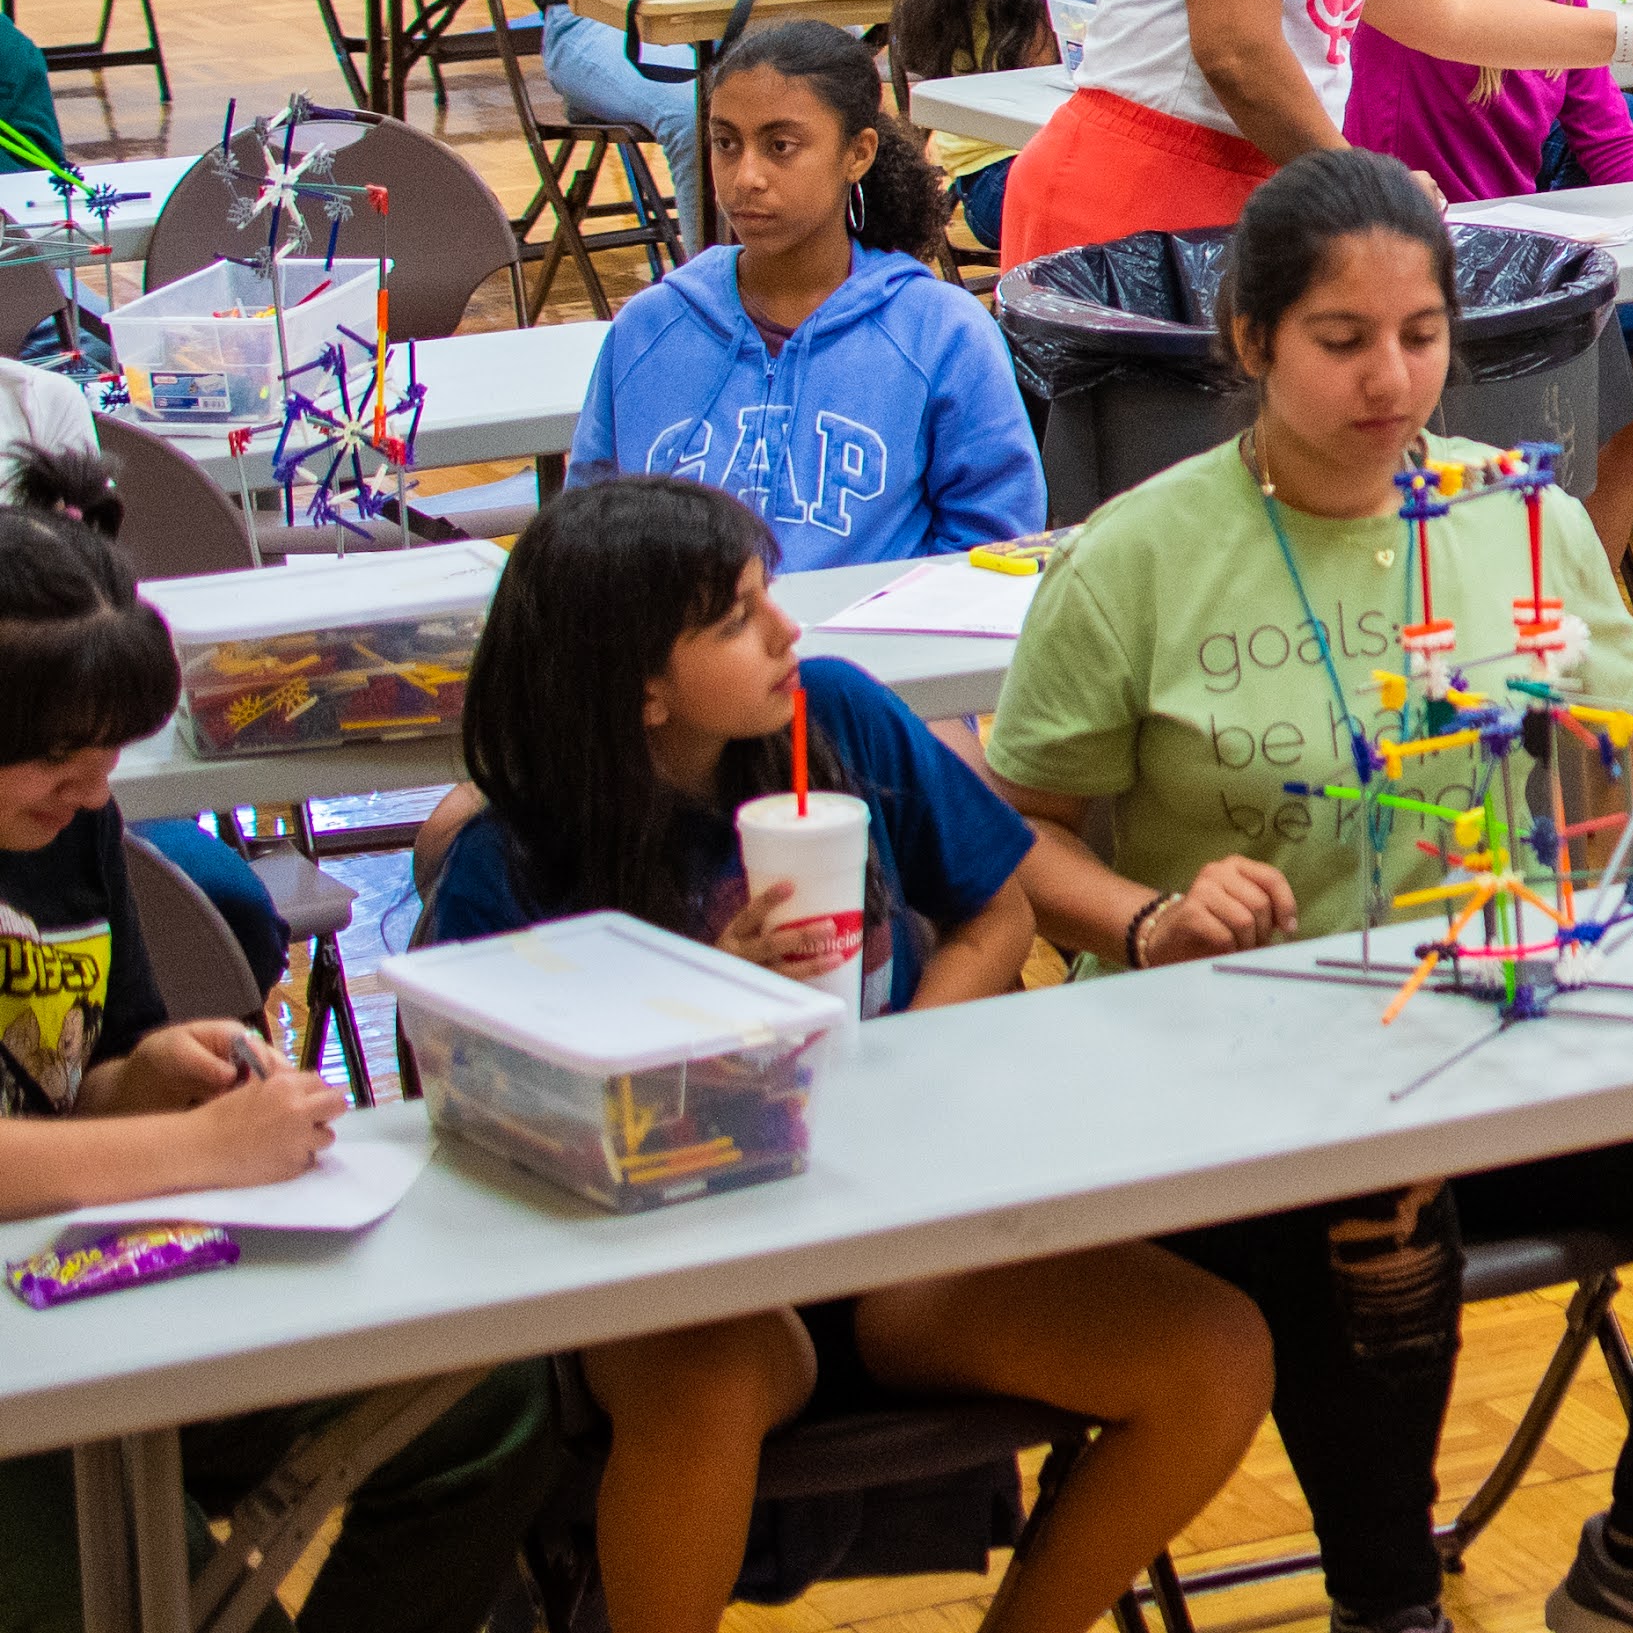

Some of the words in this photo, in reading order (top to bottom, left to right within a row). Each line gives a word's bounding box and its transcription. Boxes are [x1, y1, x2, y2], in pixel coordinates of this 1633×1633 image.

[646, 404, 887, 536] GAP
[1200, 600, 1402, 694] goals:
[1211, 713, 1305, 769] be
[1220, 790, 1311, 842] be
